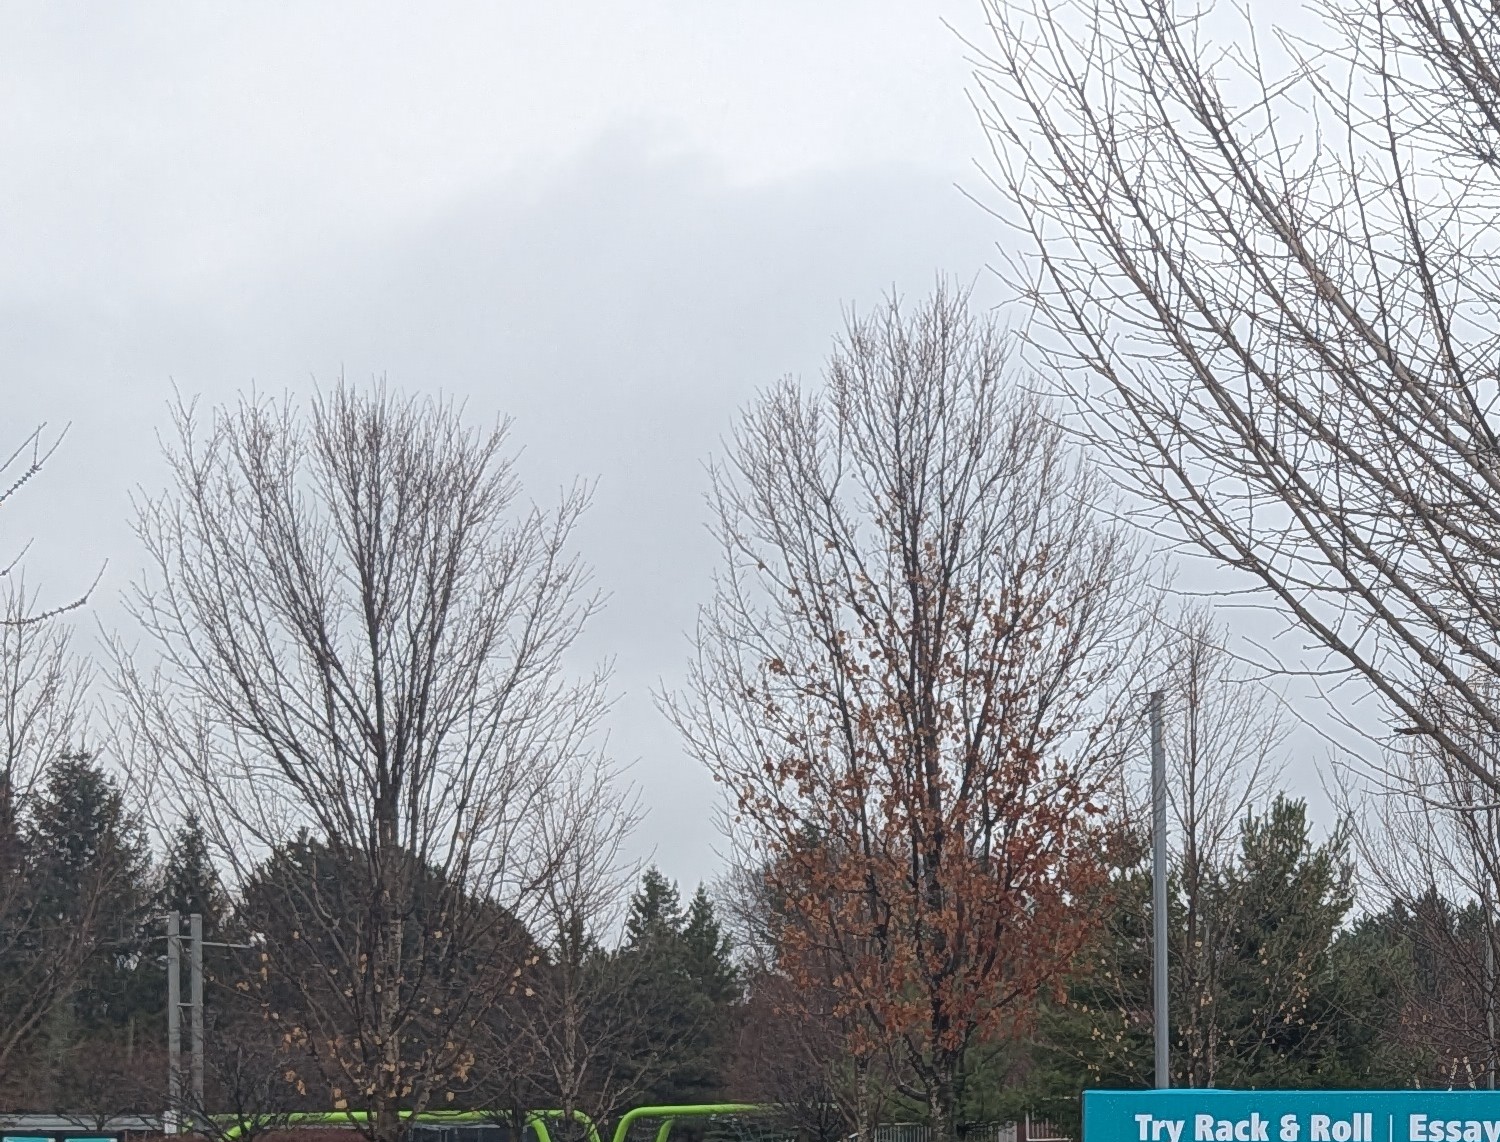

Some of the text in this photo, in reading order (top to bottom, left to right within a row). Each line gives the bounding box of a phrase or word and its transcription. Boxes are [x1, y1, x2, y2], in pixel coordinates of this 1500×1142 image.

[1194, 1112, 1270, 1142] Rack
[1279, 1113, 1300, 1142] &
[1310, 1112, 1373, 1142] Roll
